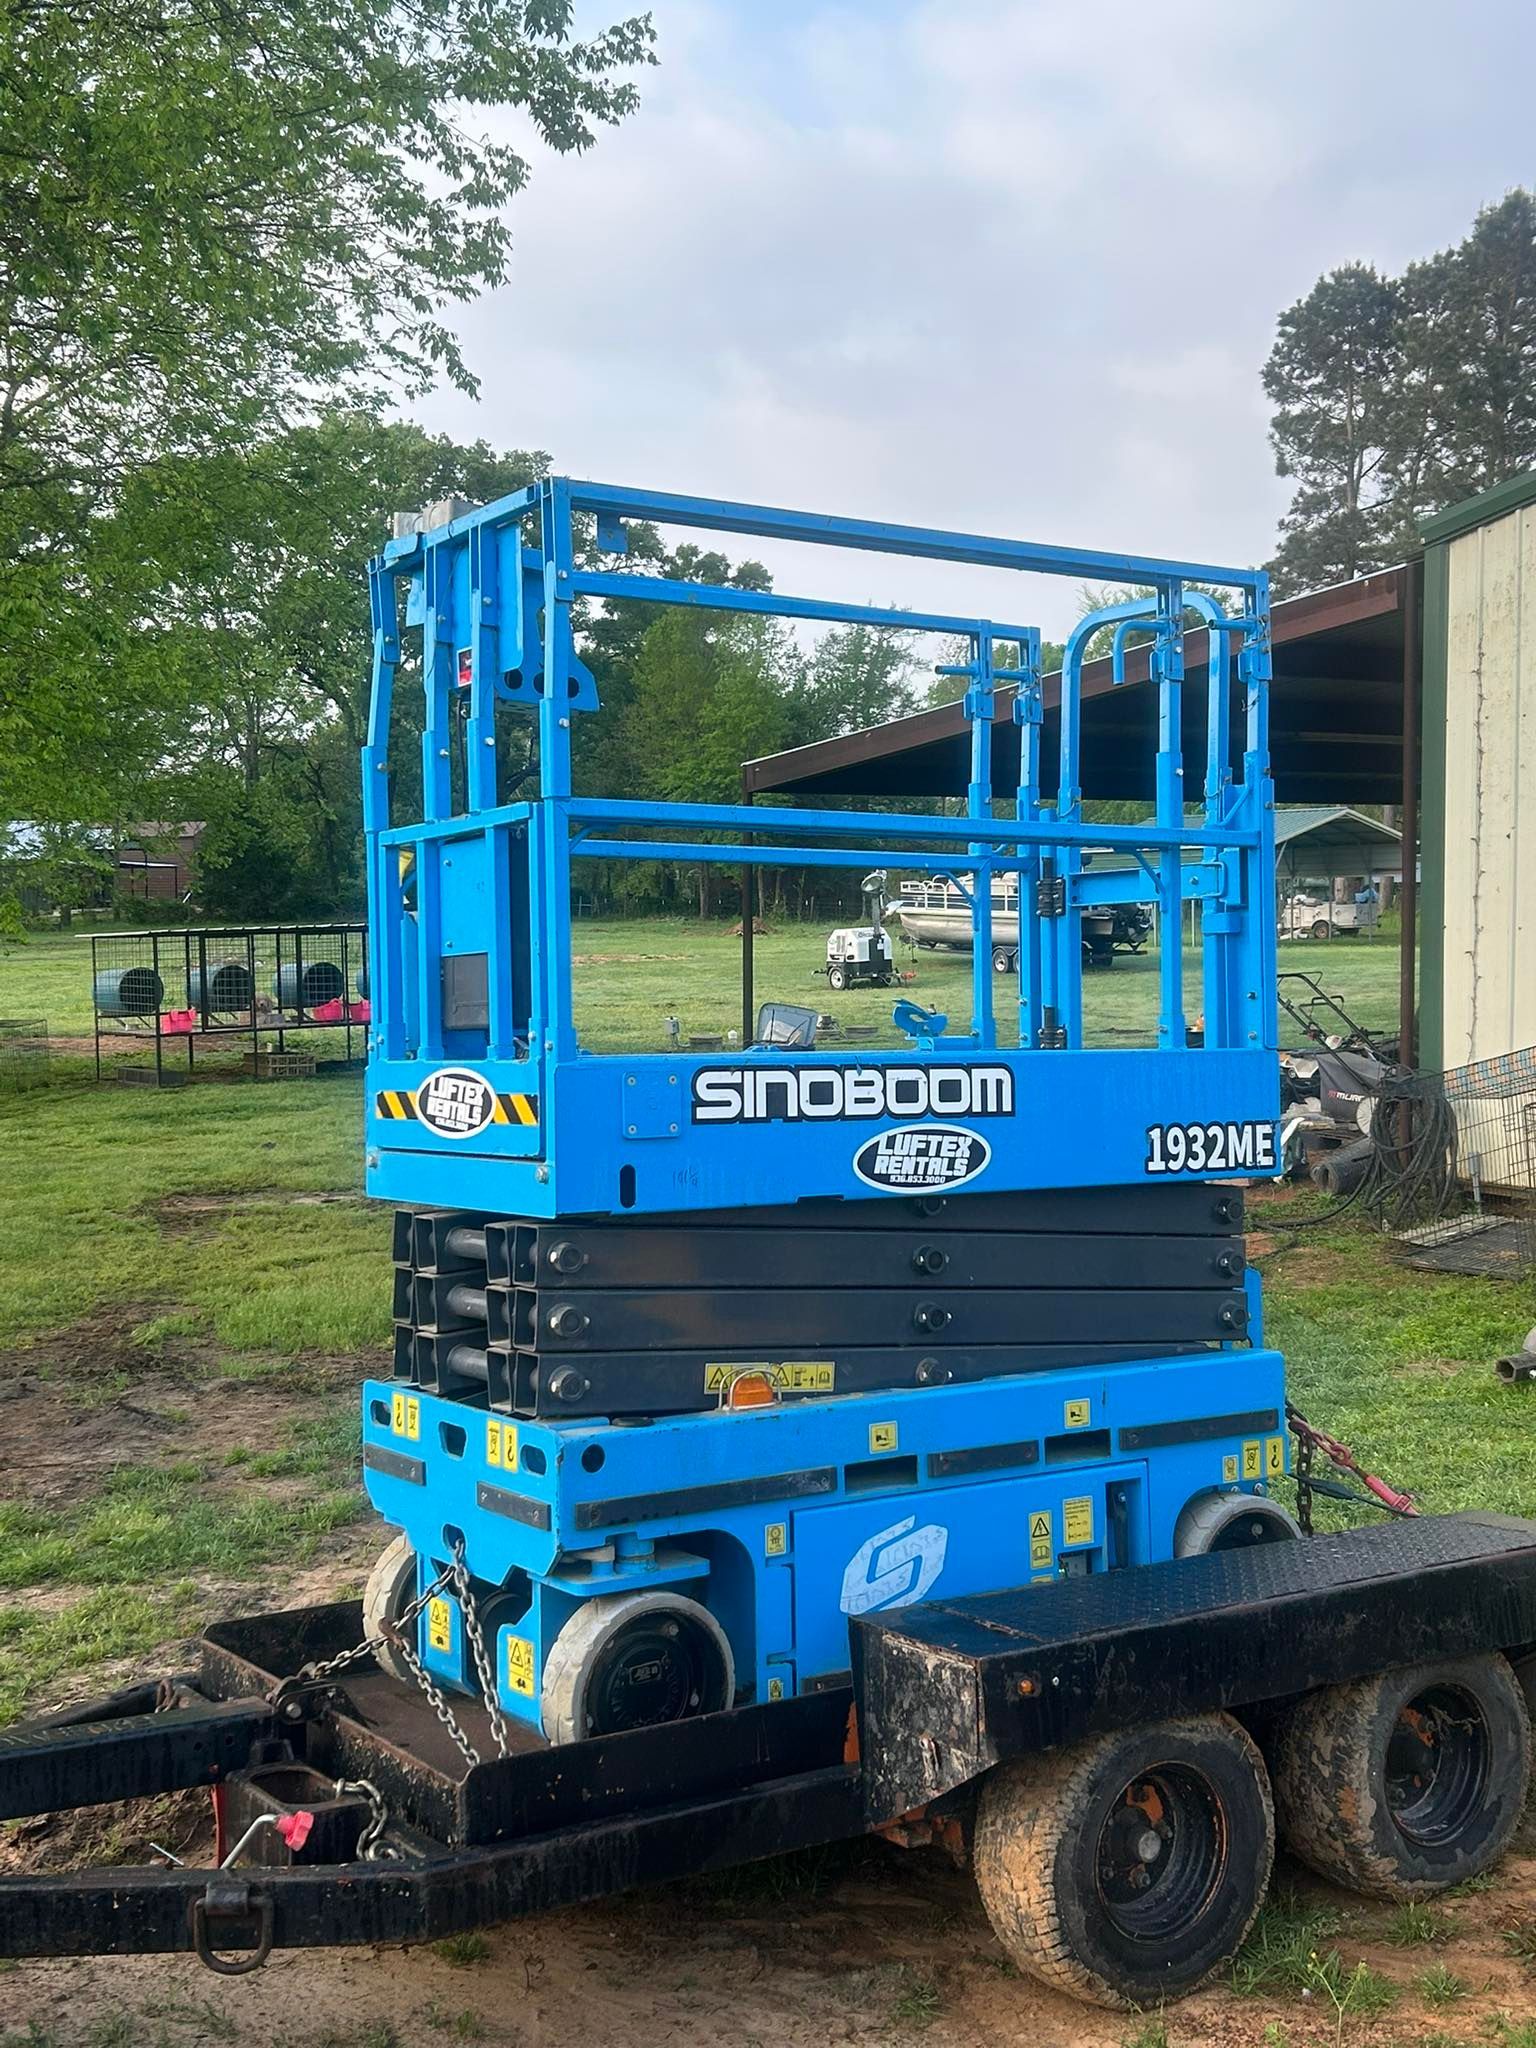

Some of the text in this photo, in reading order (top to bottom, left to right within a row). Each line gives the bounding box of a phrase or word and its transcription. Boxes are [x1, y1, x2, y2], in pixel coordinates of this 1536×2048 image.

[428, 1076, 486, 1107] LUFTEX
[694, 1067, 1013, 1119] SINOBOOM
[426, 1095, 483, 1126] RENTALS
[877, 1133, 973, 1158] LUFTEX
[1148, 1124, 1274, 1171] 1932ME
[873, 1155, 969, 1177] RENTALS
